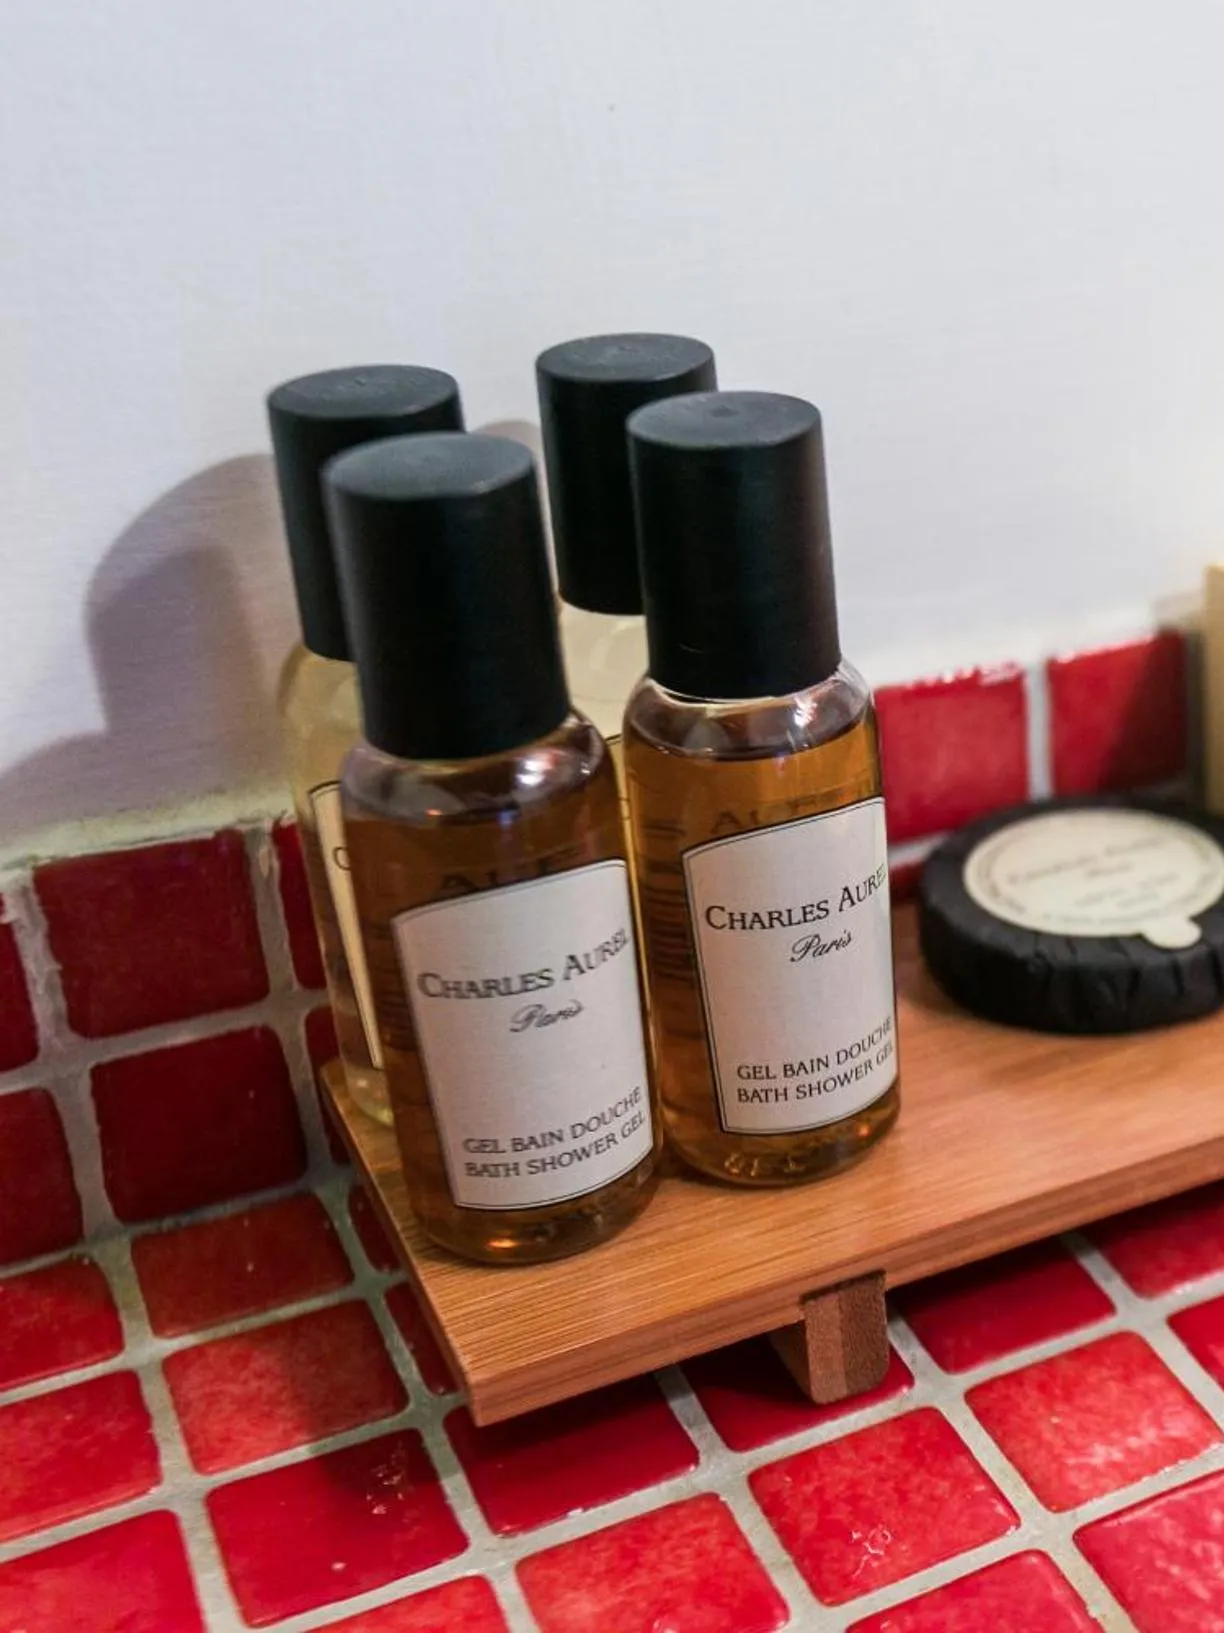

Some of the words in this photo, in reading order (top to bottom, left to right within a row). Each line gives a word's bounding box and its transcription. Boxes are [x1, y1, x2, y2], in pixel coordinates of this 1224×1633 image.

[705, 899, 829, 930] CHARLES
[789, 929, 853, 963] Paris
[417, 968, 552, 999] CHARLES
[509, 1000, 584, 1033] Paris
[737, 1065, 777, 1081] GEL
[783, 1054, 829, 1079] BAIN
[836, 1016, 892, 1066] DOUCHE
[737, 1088, 788, 1103] BATH
[795, 1058, 873, 1100] SHOWER
[463, 1136, 507, 1154] GEL
[511, 1128, 565, 1153] BAIN
[571, 1085, 642, 1140] DOUCHE
[464, 1161, 520, 1178] BATH
[526, 1131, 619, 1175] SHOWER
[621, 1112, 646, 1140] GEL
